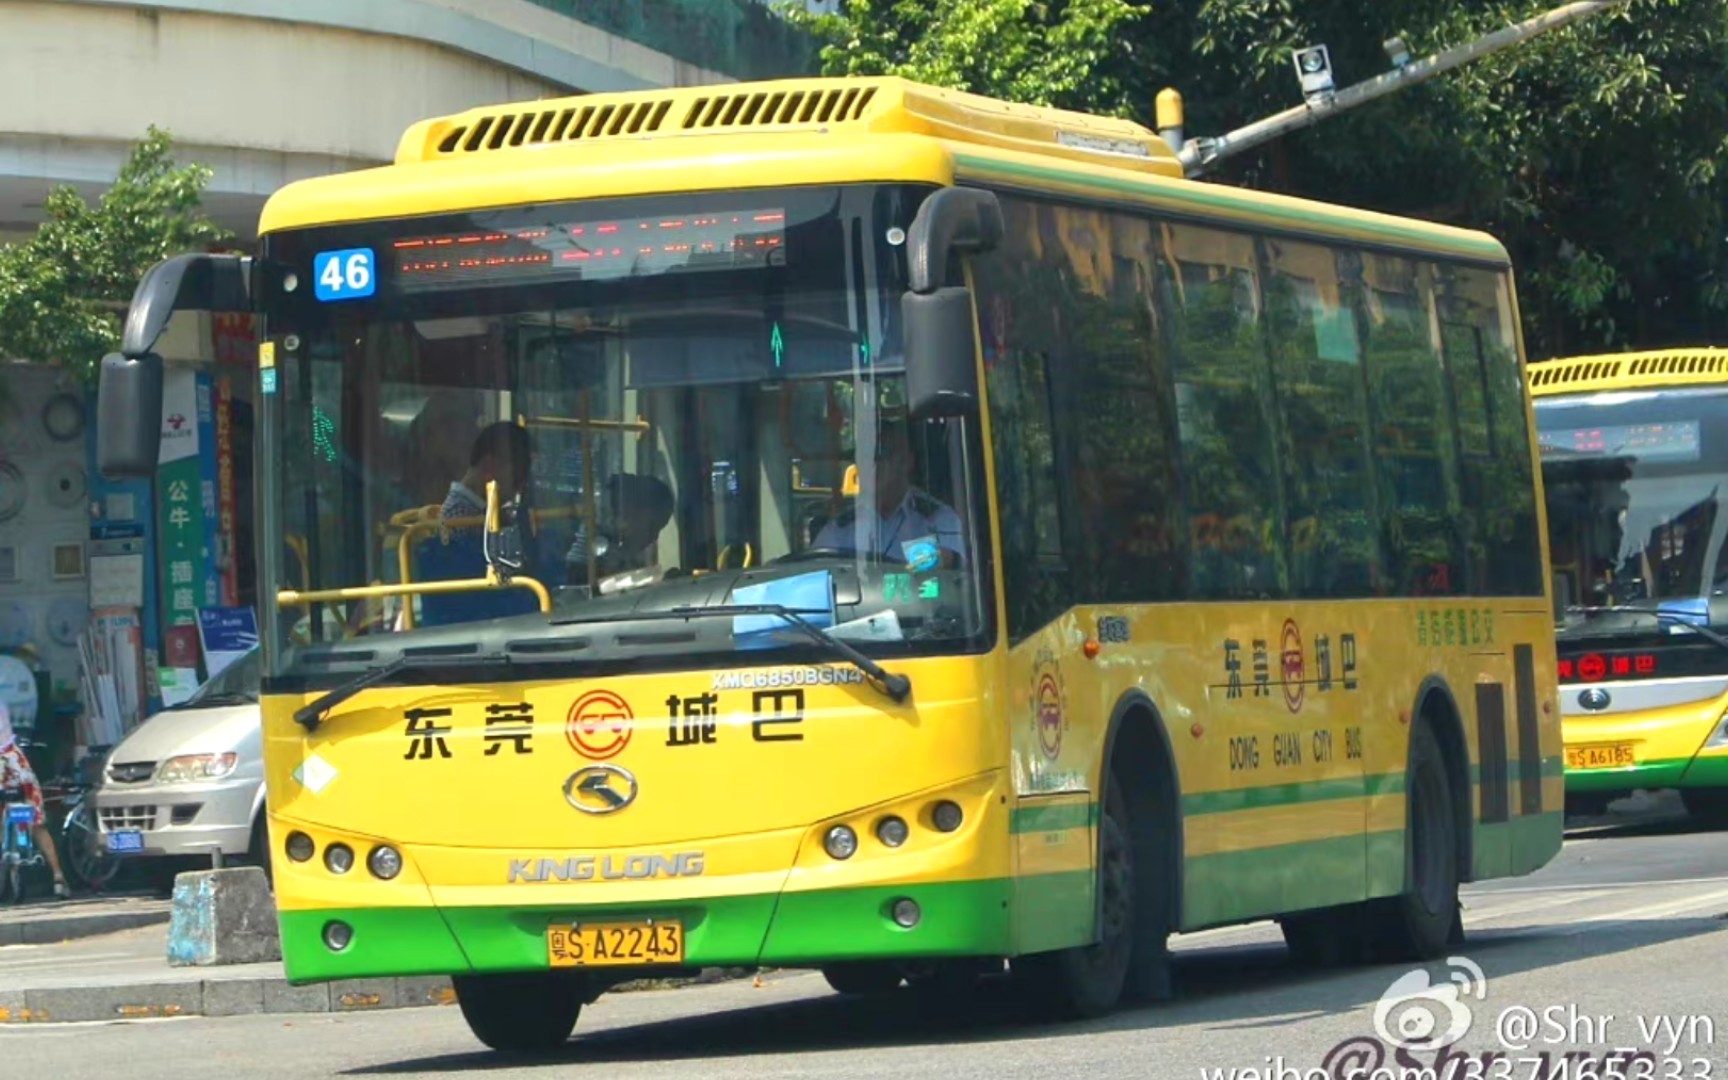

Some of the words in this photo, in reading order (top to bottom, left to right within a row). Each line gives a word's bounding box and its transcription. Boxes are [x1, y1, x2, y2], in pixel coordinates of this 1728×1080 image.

[319, 253, 370, 292] 46
[711, 666, 863, 690] XMQ6850BGN4
[403, 702, 535, 761] 东莞
[664, 688, 805, 747] 城巴
[1229, 735, 1260, 770] DONG
[1273, 731, 1303, 767] GUAN
[1312, 728, 1333, 763] CITY
[1345, 726, 1362, 760] BUS
[507, 856, 596, 884] KING
[600, 851, 704, 880] LONG
